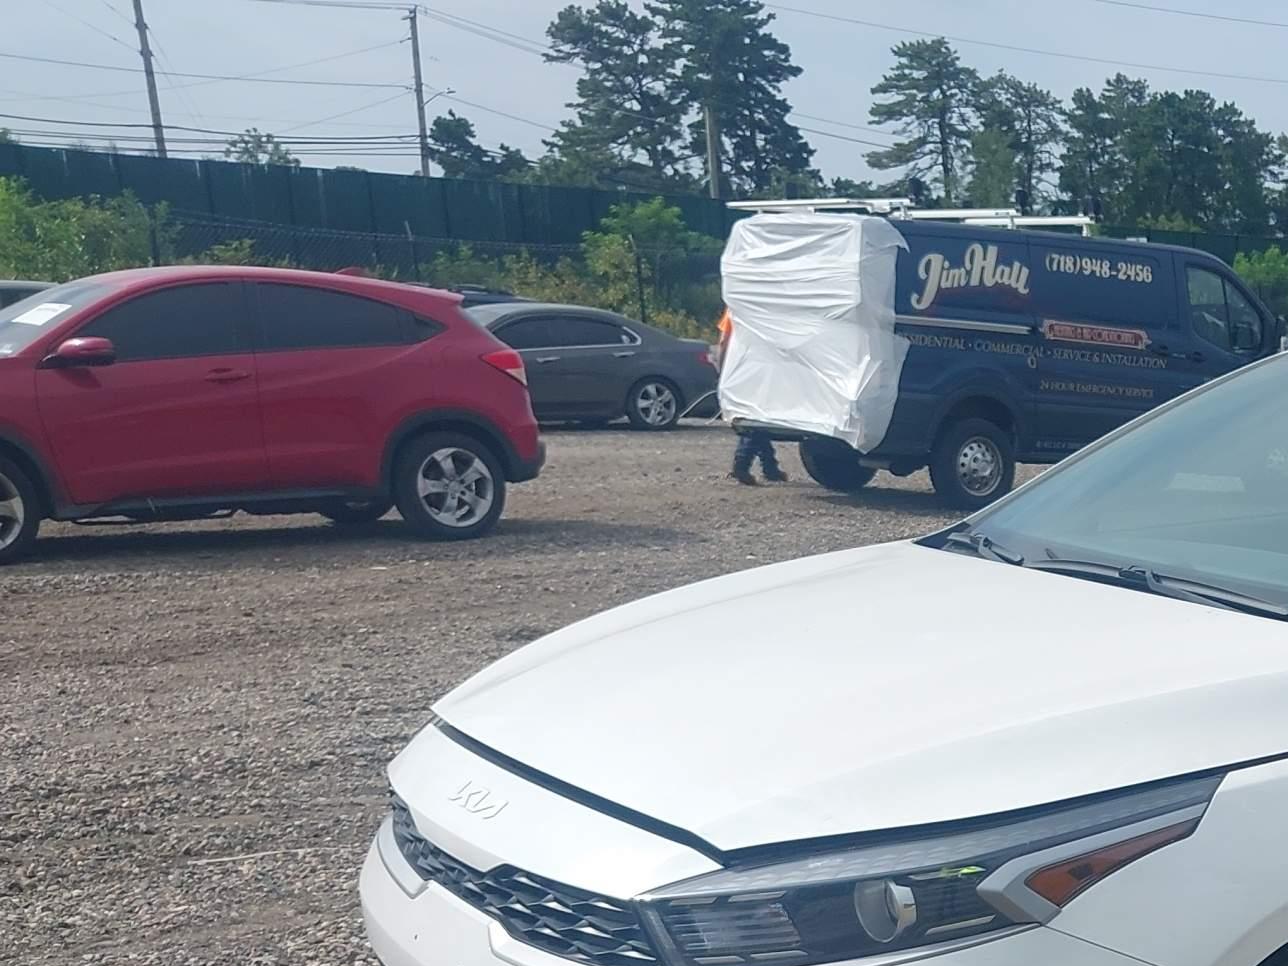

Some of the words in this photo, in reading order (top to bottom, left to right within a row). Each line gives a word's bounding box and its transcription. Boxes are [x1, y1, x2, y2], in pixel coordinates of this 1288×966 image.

[911, 253, 968, 310] Jim
[965, 243, 1029, 294] Hall
[1045, 253, 1153, 284] (718)948-2456
[898, 334, 967, 351] SIDENTIAL
[973, 340, 1044, 359] COMMERCIAL
[1053, 348, 1090, 363] SERVICE
[1092, 351, 1101, 364] &
[1102, 352, 1168, 369] INSTALLATION
